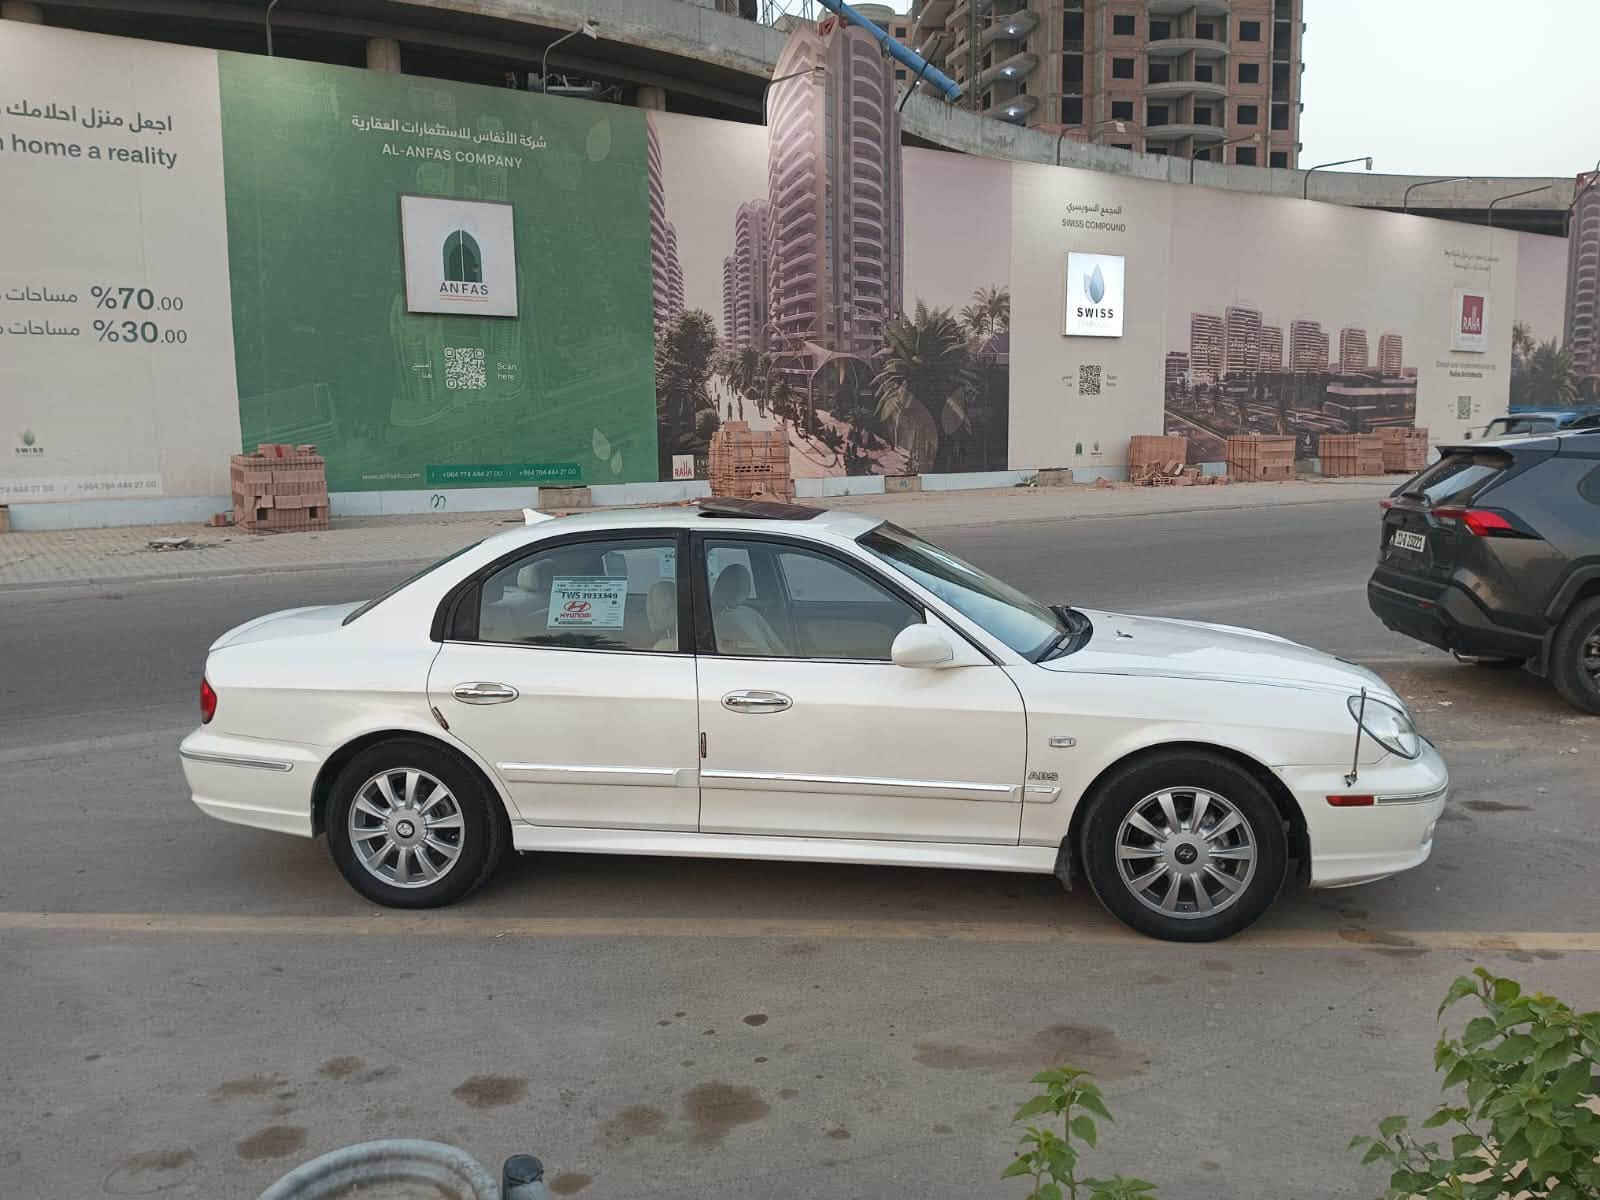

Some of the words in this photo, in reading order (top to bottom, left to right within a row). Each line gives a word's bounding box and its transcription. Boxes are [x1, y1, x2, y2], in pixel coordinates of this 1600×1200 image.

[7, 100, 76, 121] احلامك
[82, 107, 123, 128] منزل
[129, 113, 172, 134] اجعل
[352, 113, 399, 131] العقارية
[519, 134, 546, 149] شركة
[12, 134, 81, 157] home
[88, 145, 101, 159] a
[108, 147, 177, 169] reality
[382, 144, 451, 160] AL-ANFAS
[455, 152, 522, 168] COMPANY
[1062, 218, 1084, 229] SWISS
[1085, 221, 1126, 232] COMPOUND
[6, 286, 78, 303] مساحات
[440, 282, 489, 295] ANFAS
[1077, 307, 1114, 318] SWISS
[8, 320, 80, 336] مساحات
[561, 591, 580, 600] TWS
[1028, 771, 1059, 781] ABS
